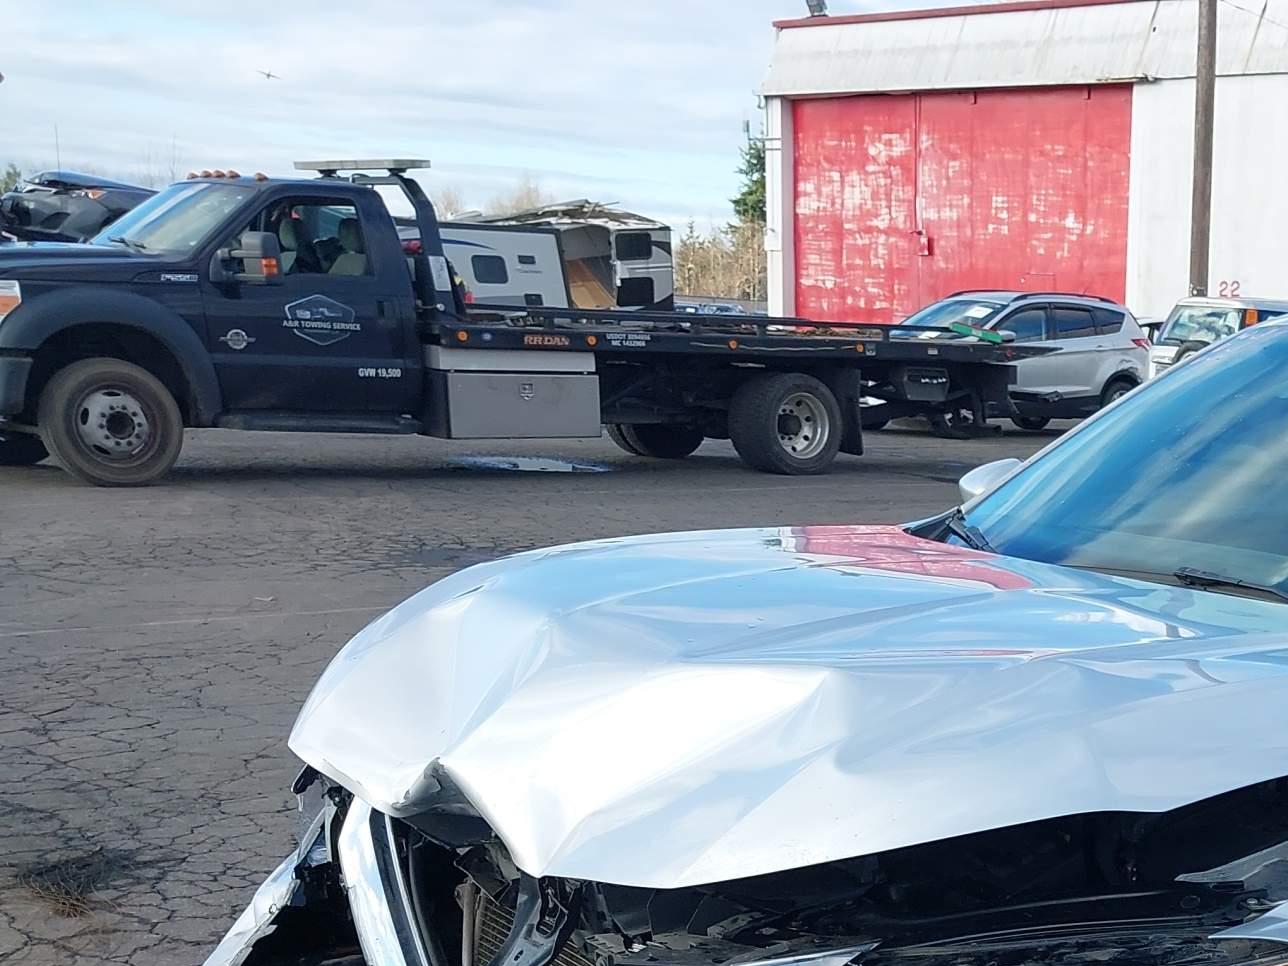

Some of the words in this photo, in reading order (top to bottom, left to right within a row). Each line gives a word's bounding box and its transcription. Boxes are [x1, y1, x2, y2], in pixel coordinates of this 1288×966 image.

[1219, 280, 1240, 297] 22
[301, 320, 332, 329] TOWING
[332, 322, 361, 331] SERVICE
[358, 367, 376, 377] GVW
